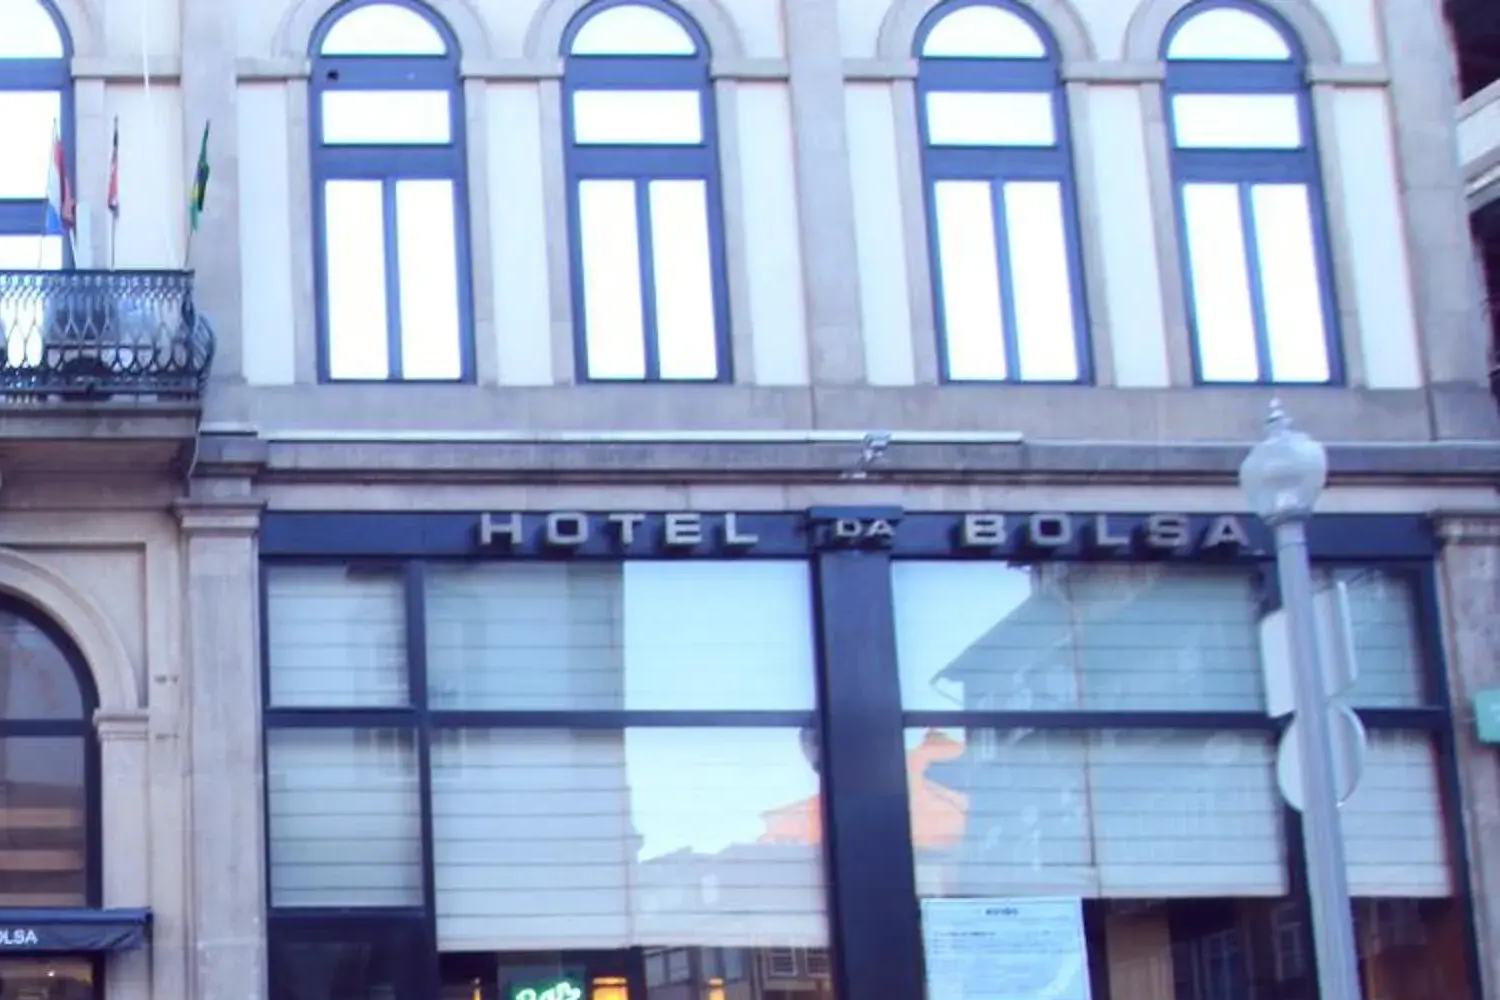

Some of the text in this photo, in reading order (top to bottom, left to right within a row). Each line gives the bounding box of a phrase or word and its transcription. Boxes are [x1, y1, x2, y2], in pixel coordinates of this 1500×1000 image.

[479, 512, 1250, 547] HOTEL DA BOLSA
